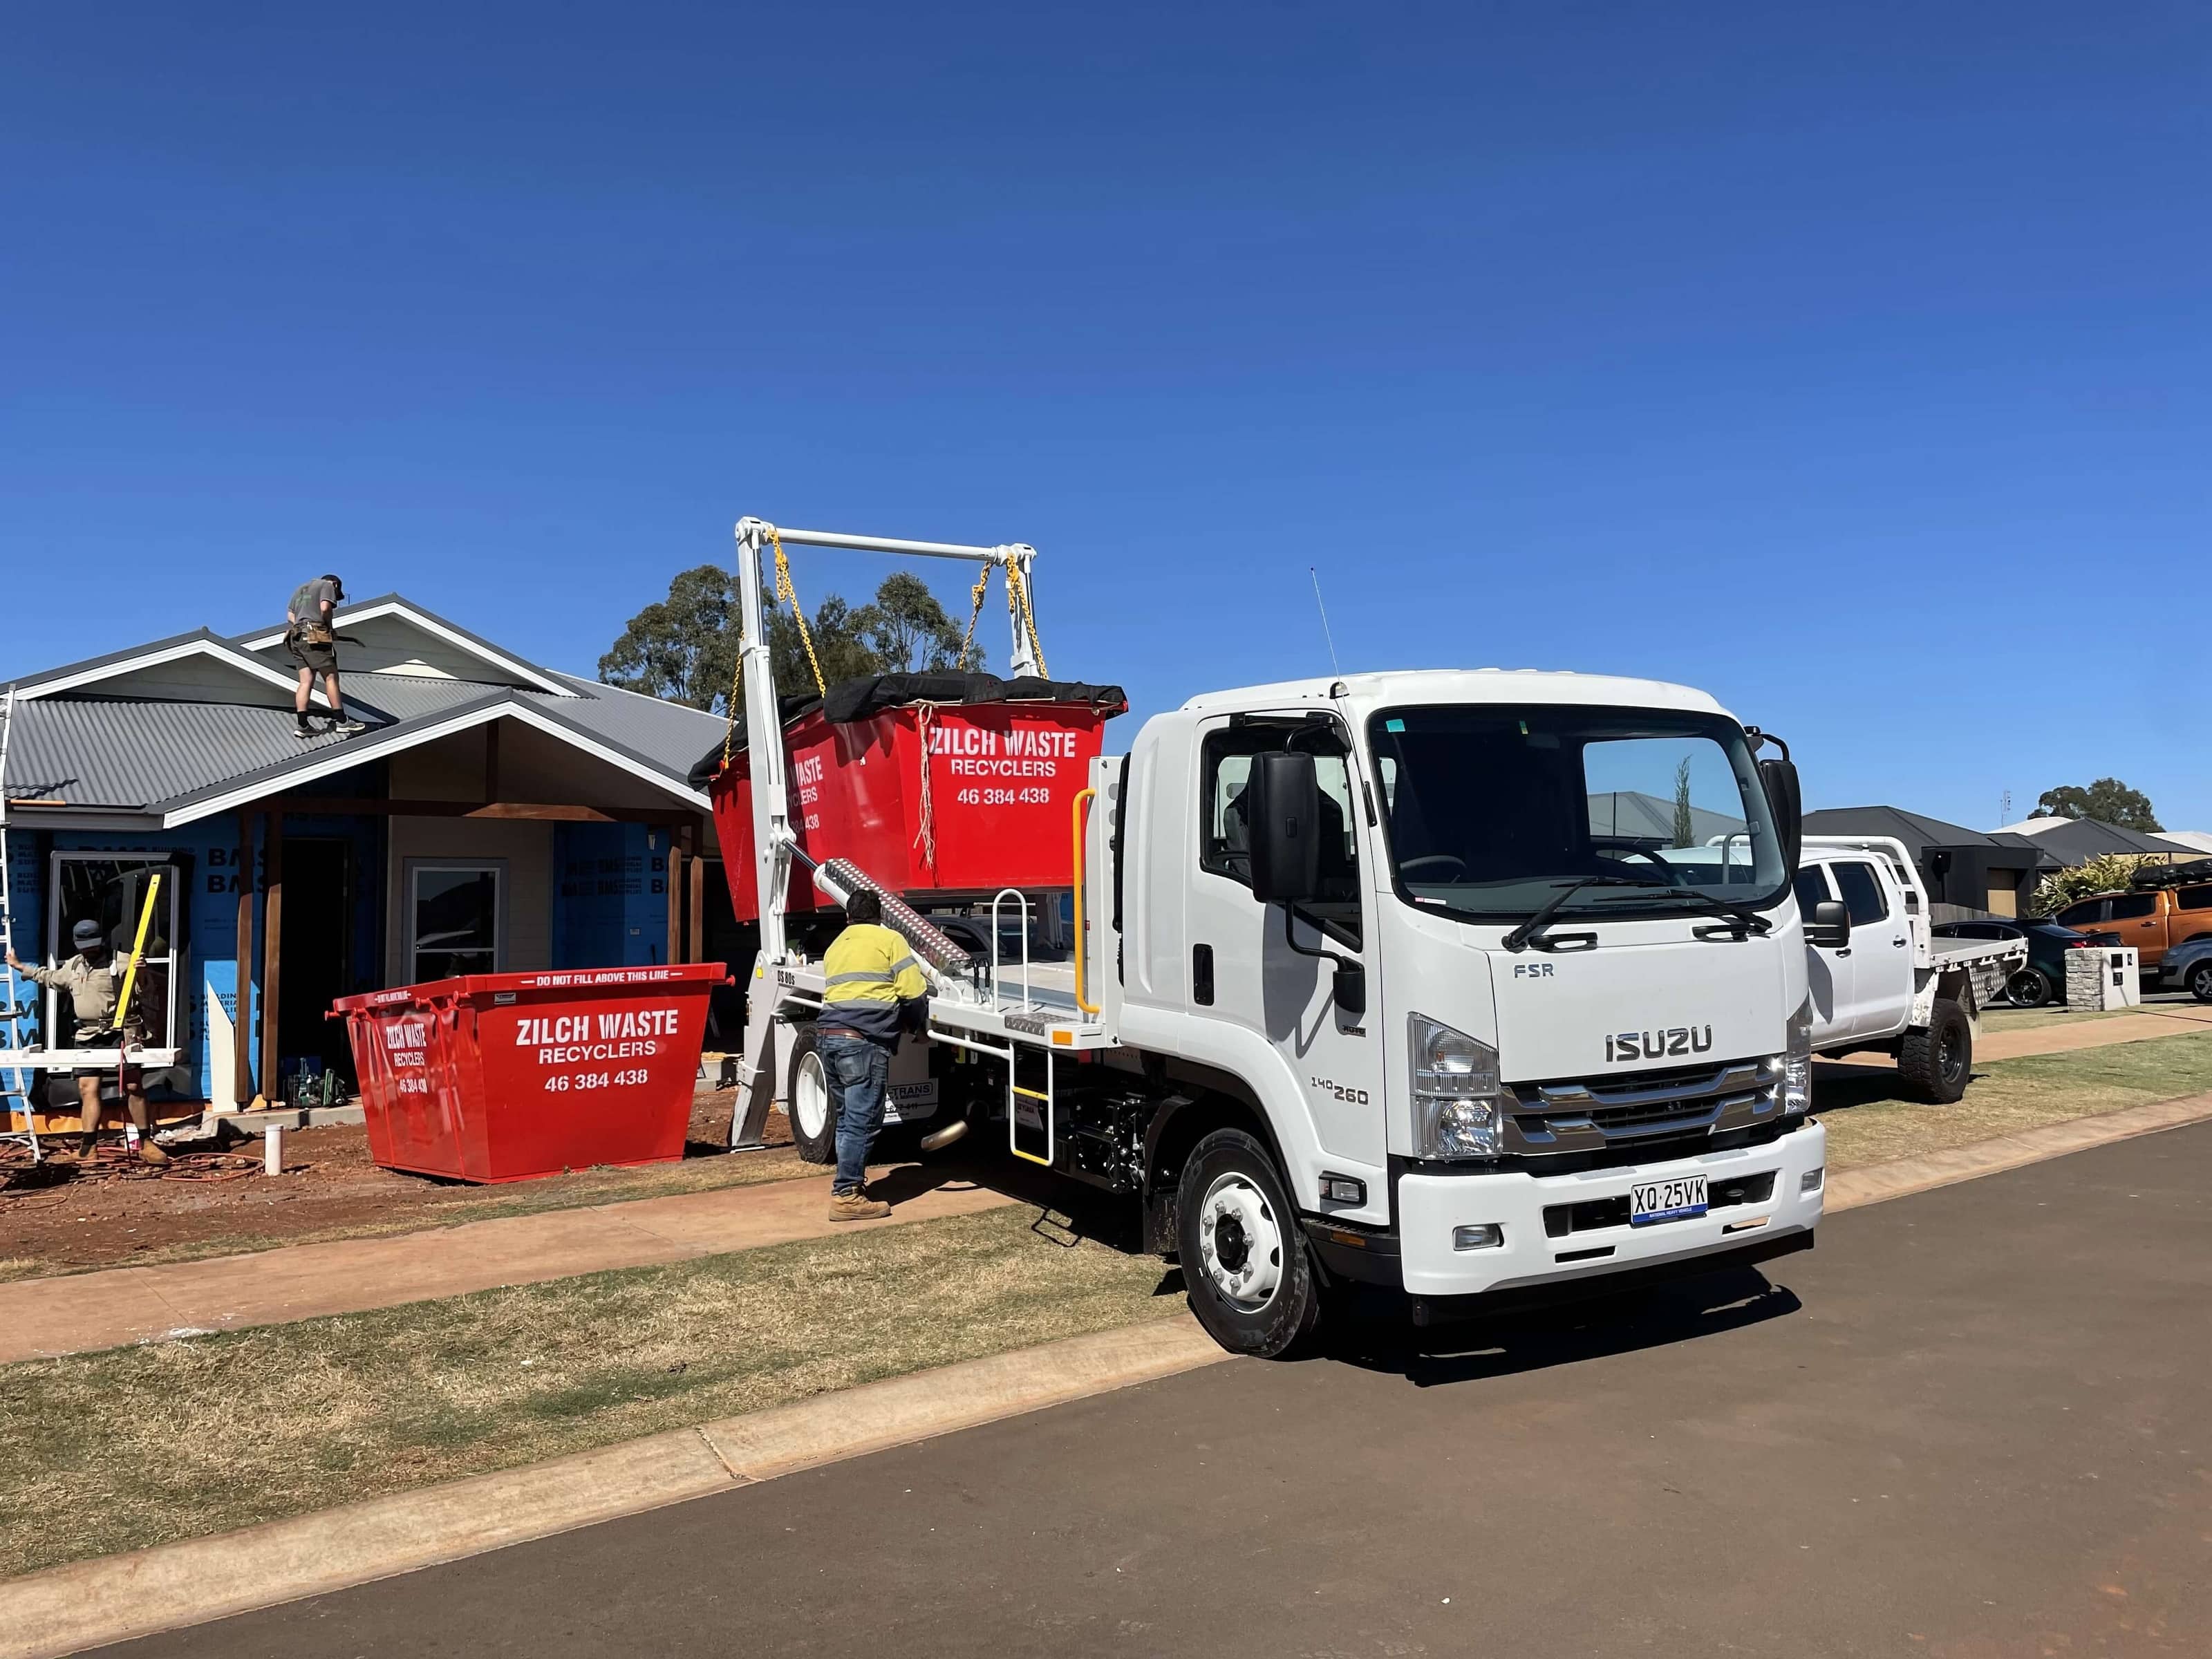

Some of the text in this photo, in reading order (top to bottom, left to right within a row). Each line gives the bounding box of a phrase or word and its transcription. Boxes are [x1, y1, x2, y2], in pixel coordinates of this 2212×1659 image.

[929, 727, 1076, 758] ZILCH WASTE
[790, 755, 824, 788] WASTE
[951, 759, 1056, 778] RECYCLERS
[957, 787, 1049, 805] 46 384 438
[805, 814, 820, 830] 438
[537, 970, 669, 986] DO NOT FILL ABOVE THIS LINE
[778, 970, 784, 982] DS
[1514, 963, 1554, 978] FSR
[386, 1023, 427, 1049] ZILCH WASTE
[516, 1009, 679, 1046] ZILCH WASTE
[538, 1040, 657, 1065] RECYCLERS
[1605, 1024, 1712, 1062] ISUZU
[393, 1051, 425, 1067] RECYCLERS
[400, 1078, 406, 1094] 46
[406, 1078, 418, 1094] 384
[545, 1069, 648, 1092] 46 384 438
[1311, 1077, 1368, 1105] 140 260
